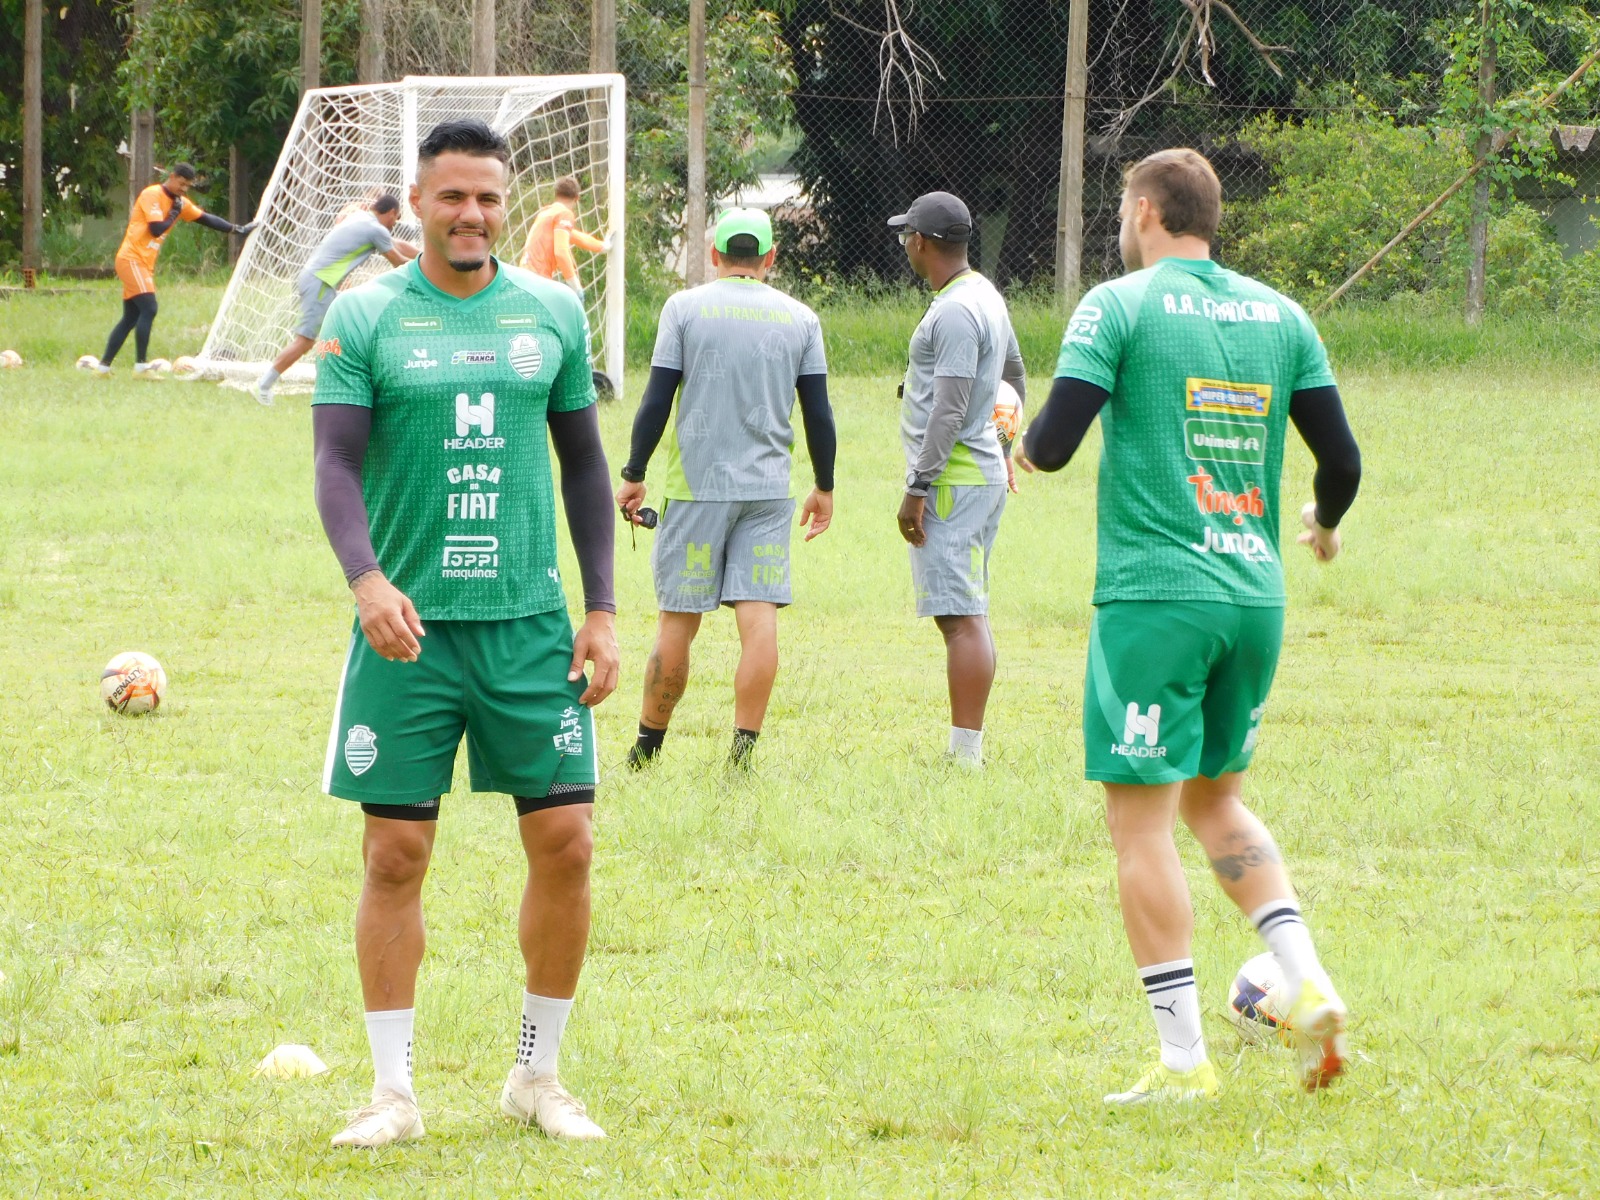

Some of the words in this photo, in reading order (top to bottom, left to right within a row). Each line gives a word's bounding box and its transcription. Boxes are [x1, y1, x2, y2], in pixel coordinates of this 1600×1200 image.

[403, 359, 438, 370] Junpe
[443, 437, 506, 450] HEADER
[1193, 433, 1240, 450] Unimed
[446, 464, 501, 484] CASA
[447, 493, 500, 520] FIAT
[442, 567, 498, 581] maquinas
[113, 666, 142, 700] PENALTY
[1111, 743, 1167, 758] HEADER
